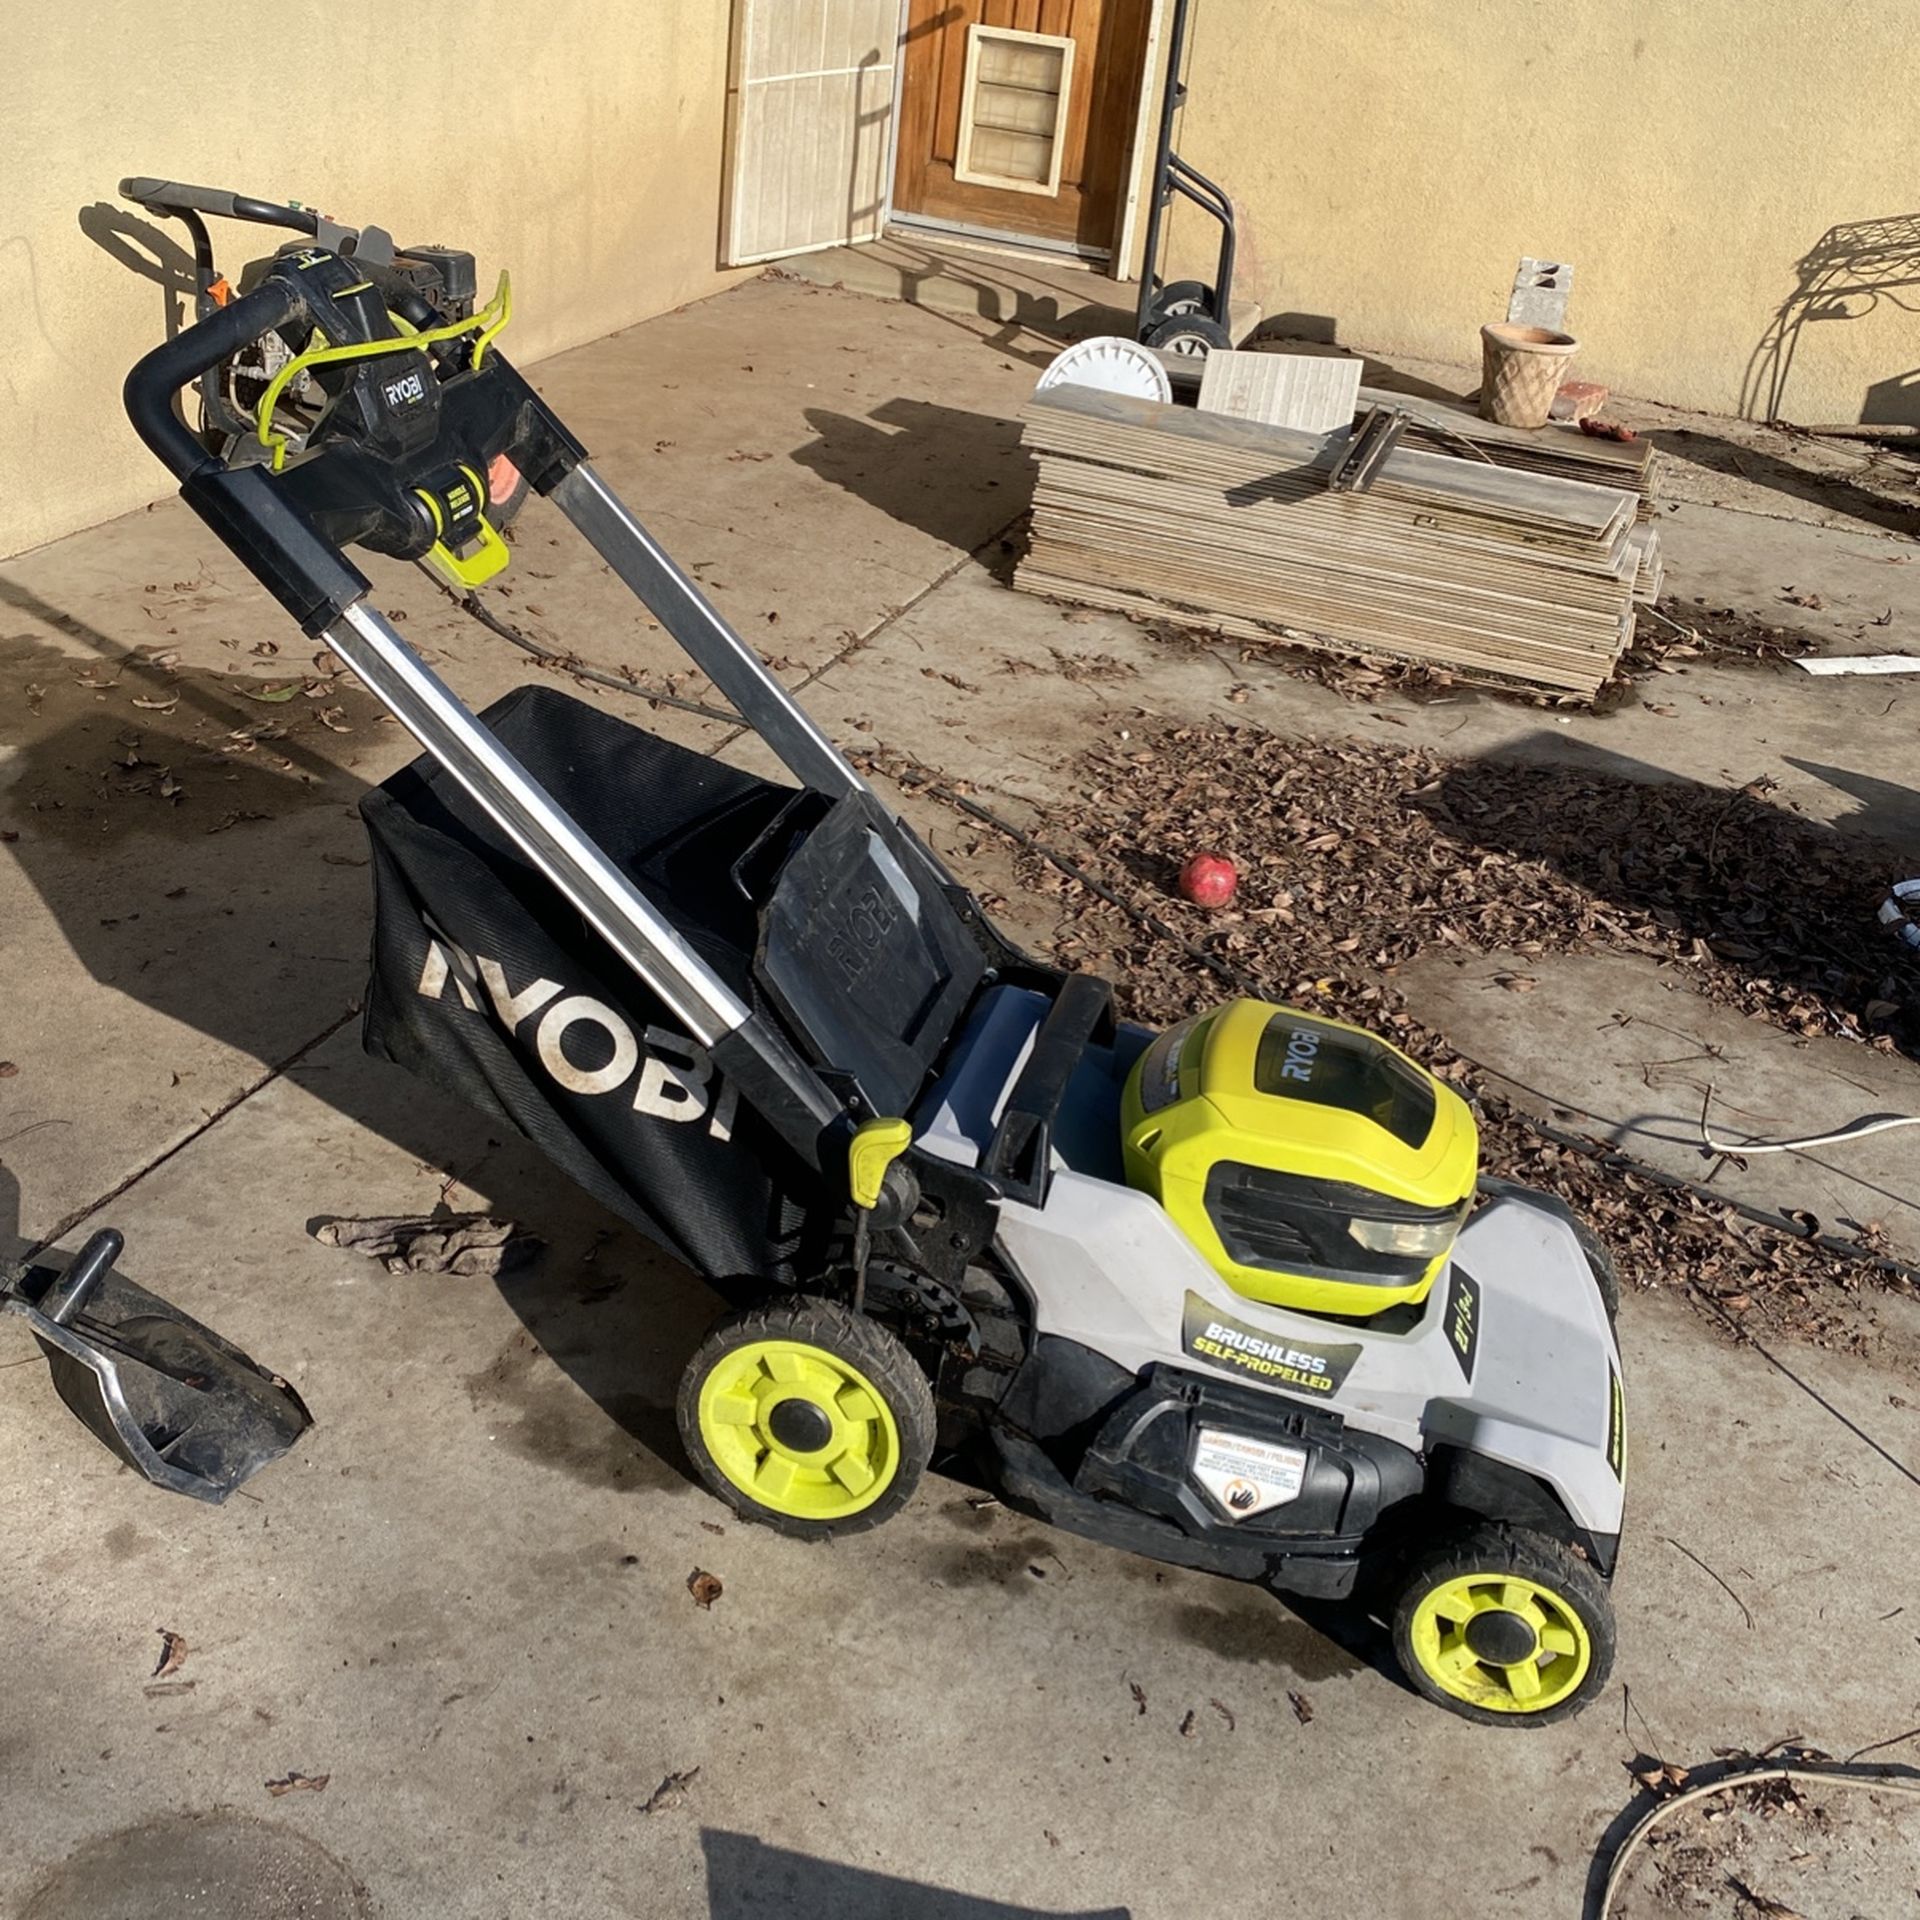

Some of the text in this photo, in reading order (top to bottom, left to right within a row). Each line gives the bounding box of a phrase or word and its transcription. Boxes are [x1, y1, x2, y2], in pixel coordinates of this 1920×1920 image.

[385, 374, 422, 406] RYOBI
[1281, 1027, 1321, 1081] RYOBI
[1192, 1336, 1333, 1391] SELF-PROPELLED
[1204, 1322, 1327, 1373] BRUSHLESS
